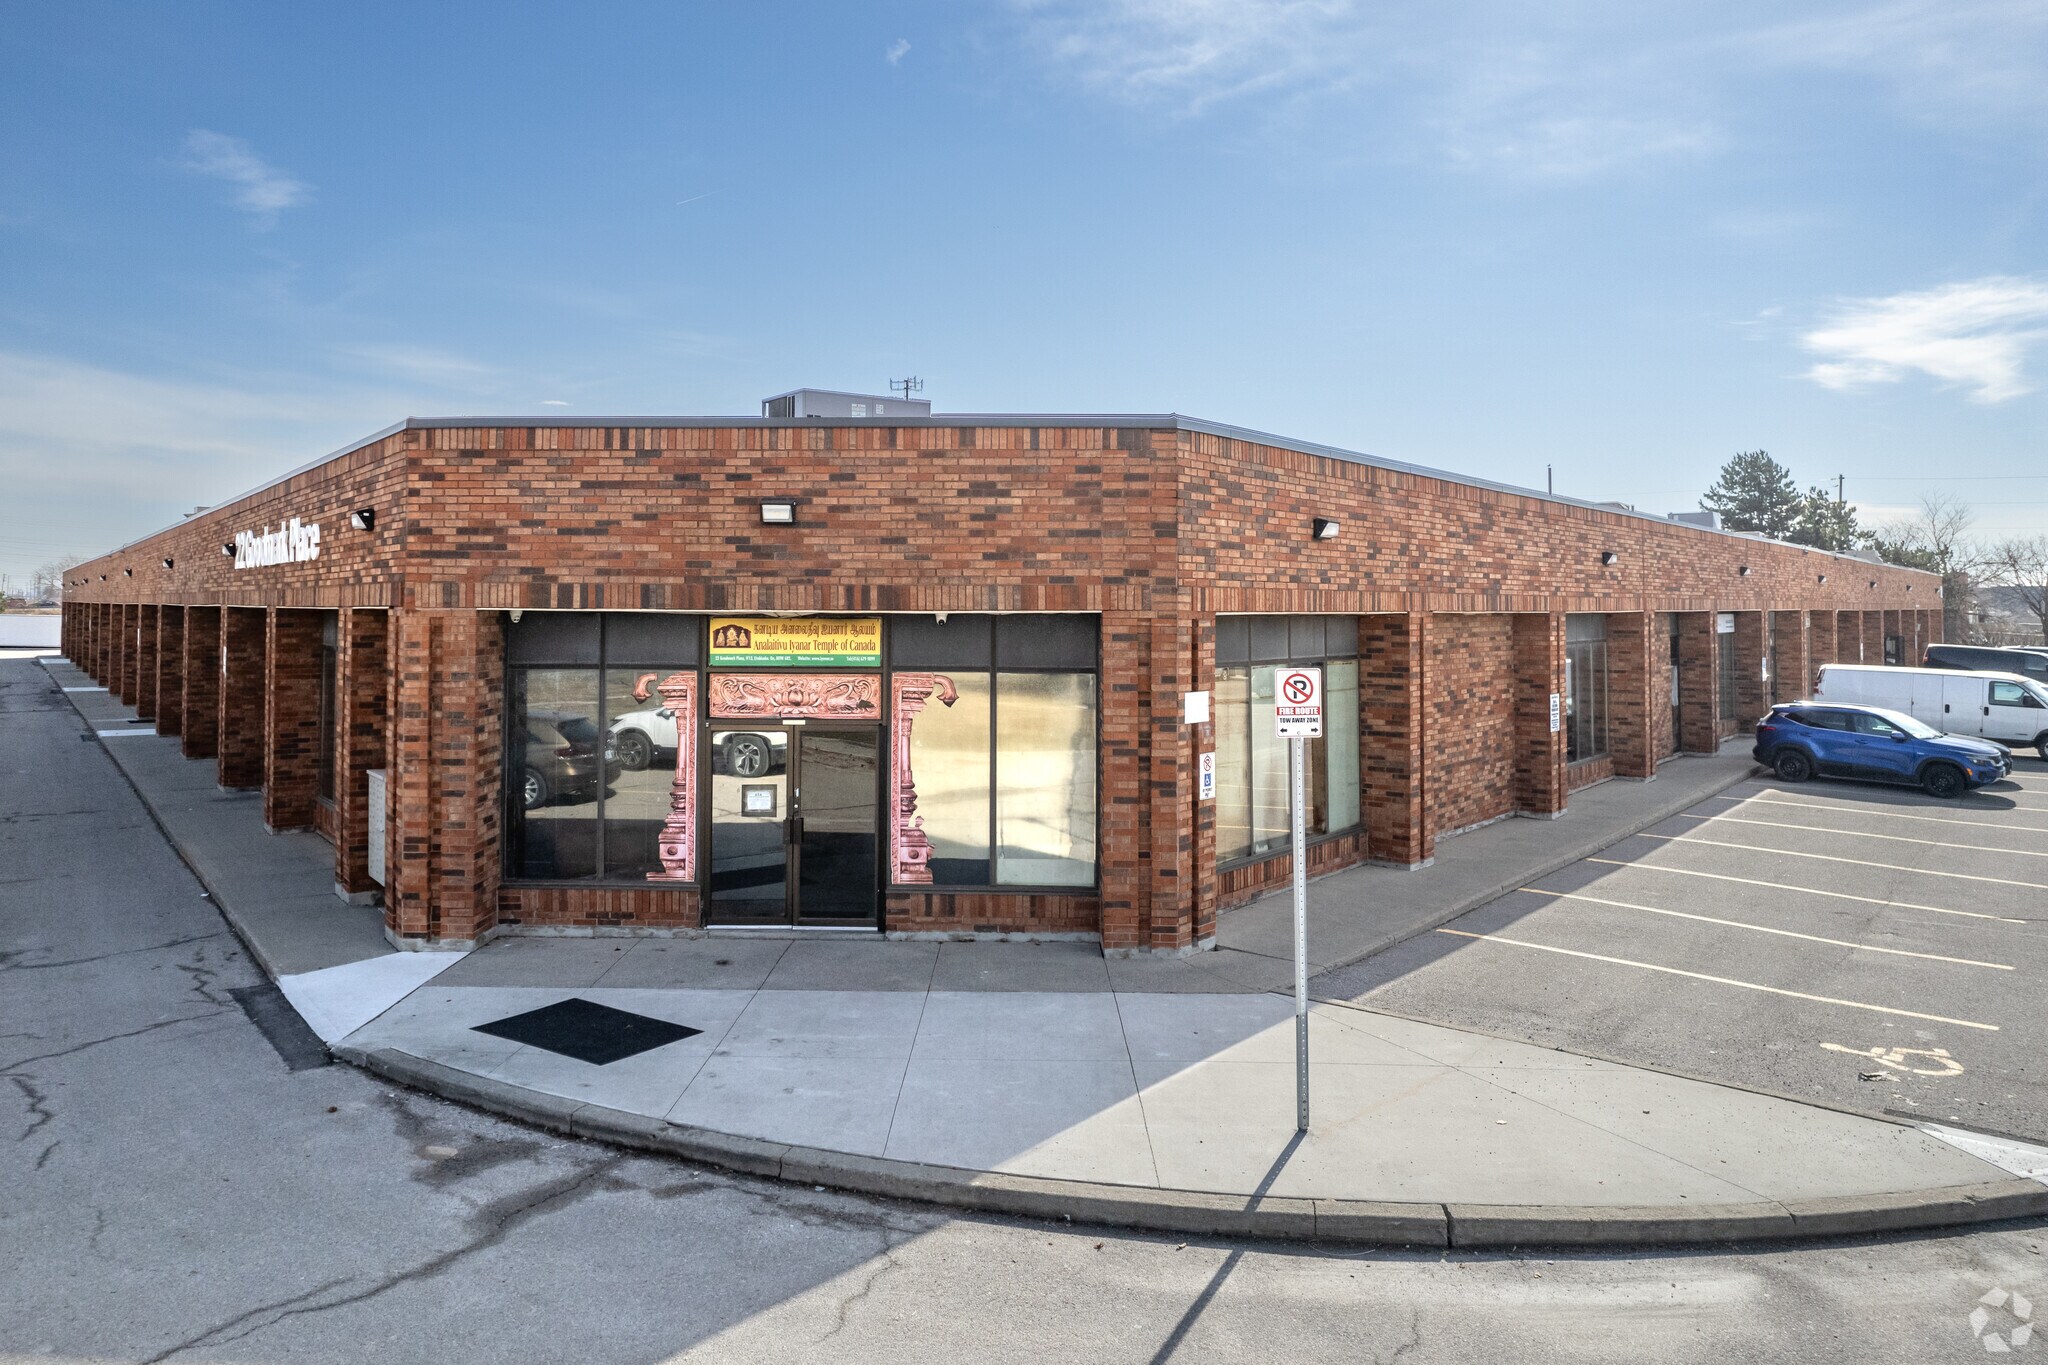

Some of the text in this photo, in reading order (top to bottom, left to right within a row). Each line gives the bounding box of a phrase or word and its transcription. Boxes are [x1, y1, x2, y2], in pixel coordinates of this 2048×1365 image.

[234, 532, 246, 570] 22
[290, 517, 320, 562] Place
[754, 638, 876, 653] Analaitivu Iyanar Temple of Canada
